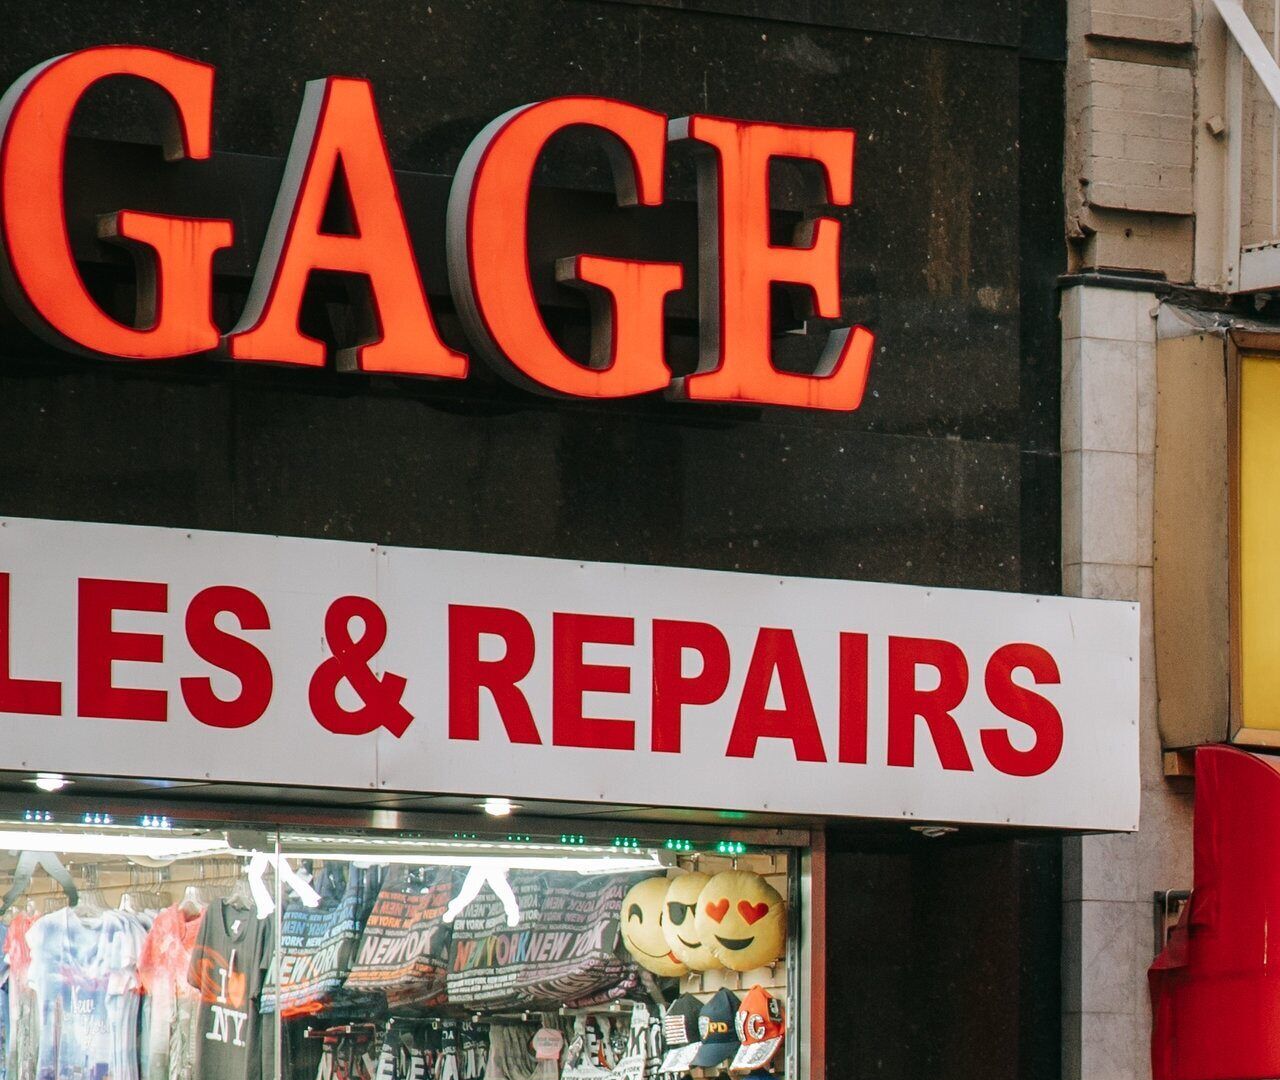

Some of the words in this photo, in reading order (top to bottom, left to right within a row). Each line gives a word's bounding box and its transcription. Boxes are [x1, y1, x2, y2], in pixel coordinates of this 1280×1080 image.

[1, 44, 875, 412] GAGE
[309, 595, 414, 738] &
[447, 604, 1065, 777] REPAIRS
[205, 1005, 247, 1047] NY
